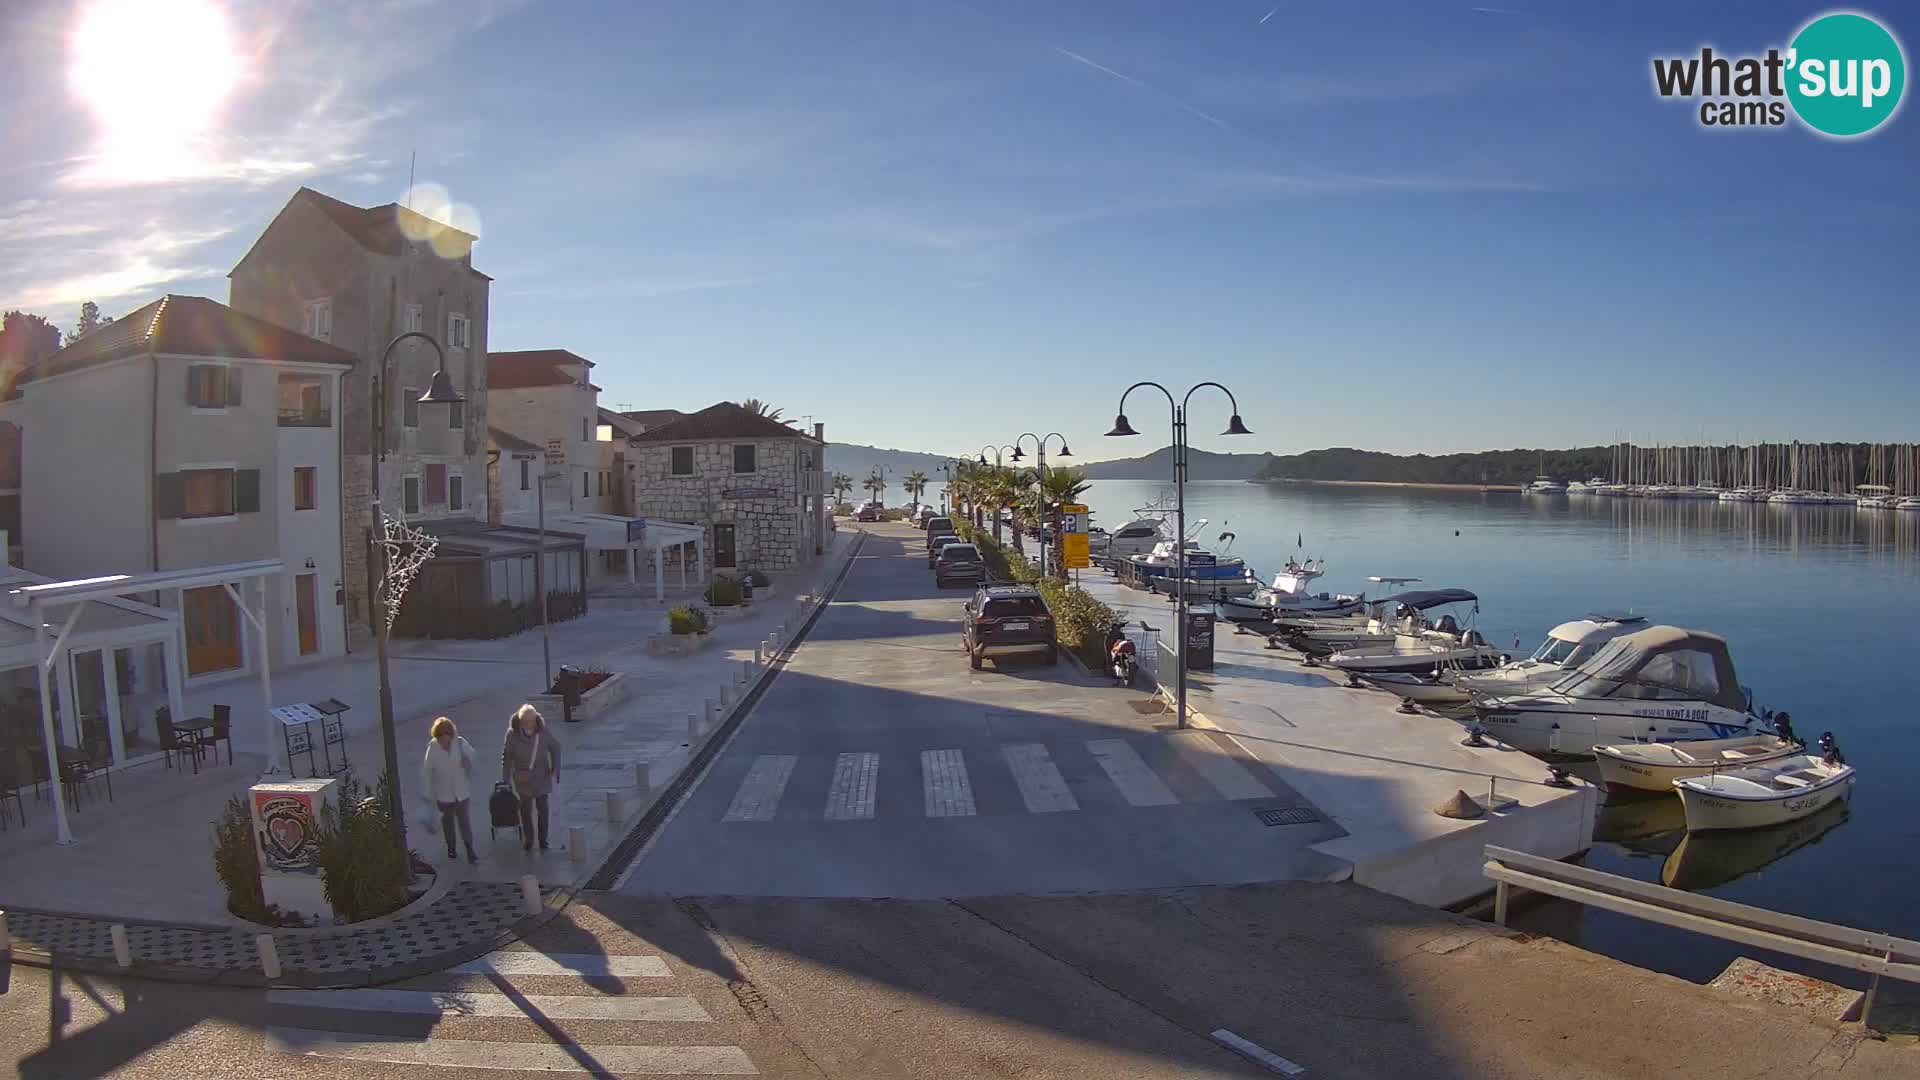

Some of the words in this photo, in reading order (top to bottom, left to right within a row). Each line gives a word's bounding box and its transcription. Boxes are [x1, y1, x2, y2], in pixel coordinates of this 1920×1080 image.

[1065, 515, 1076, 531] P
[1666, 708, 1685, 719] RENT
[1691, 709, 1710, 721] BOAT
